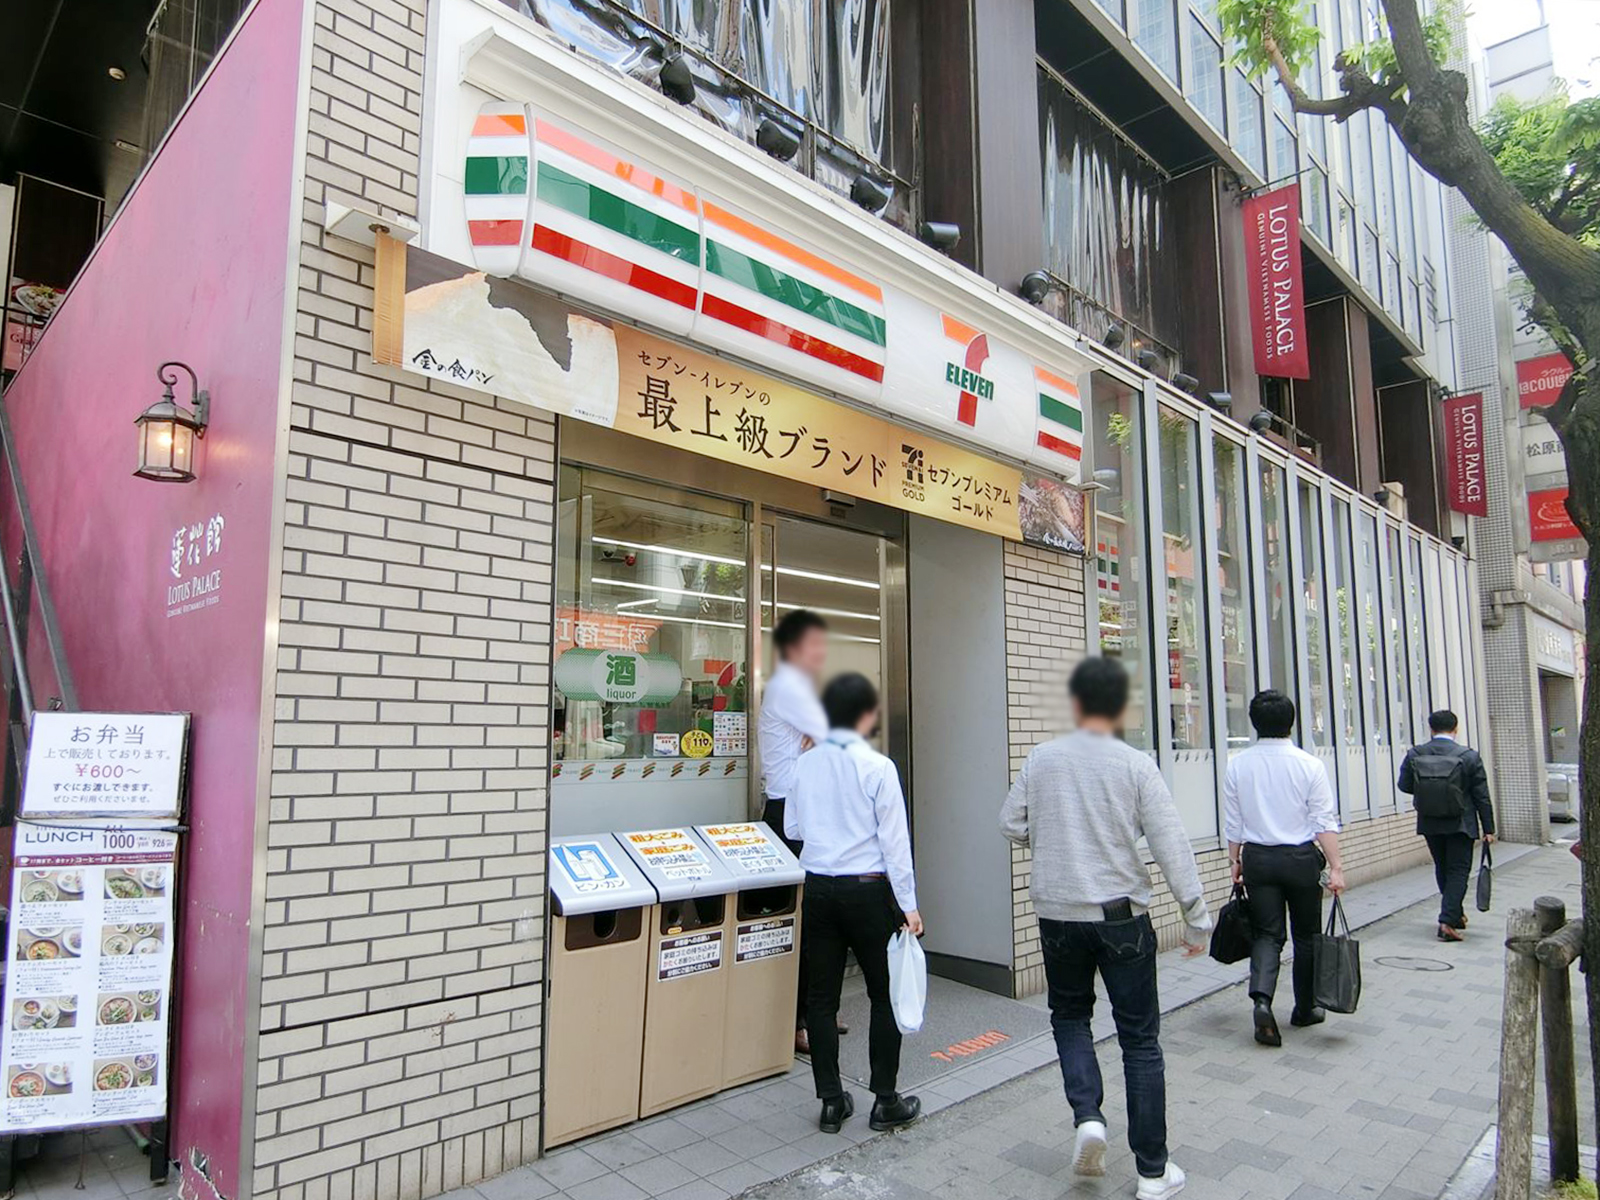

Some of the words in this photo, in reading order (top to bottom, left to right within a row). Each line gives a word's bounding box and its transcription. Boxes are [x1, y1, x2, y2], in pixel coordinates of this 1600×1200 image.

[1257, 212, 1267, 257] GENUINE
[1268, 204, 1291, 273] LOTUS
[1261, 260, 1272, 322] VIETNAMESE
[1273, 278, 1295, 356] PALACE
[1264, 325, 1274, 360] FOODS
[412, 349, 495, 385] 金の食パン
[637, 374, 887, 488] 最上級ブランド
[1461, 405, 1478, 449] LOTUS
[902, 480, 925, 491] PREMIUM
[927, 464, 1012, 505] セブンプレミアム
[1465, 453, 1481, 503] PALACE
[902, 488, 925, 502] GOLD
[951, 496, 993, 522] ゴールド
[168, 581, 191, 606] LOTUS
[192, 569, 221, 598] PALACE
[606, 654, 637, 686] 酒
[606, 688, 637, 700] liquor
[70, 724, 145, 745] お弁当
[44, 748, 171, 761] 上で販売しております。
[53, 783, 154, 792] すぐにお渡しできます。
[53, 794, 151, 804] ぜひご利用くださいませ。
[25, 831, 94, 844] LUNCH
[628, 832, 686, 842] 粗大ごみ
[706, 826, 757, 835] 粗大ごみ
[102, 834, 135, 849] 1000
[152, 839, 166, 848] 926
[639, 844, 697, 855] 家庭ごみ
[715, 837, 768, 846] 家庭ごみ
[665, 867, 713, 877] ペットボトル
